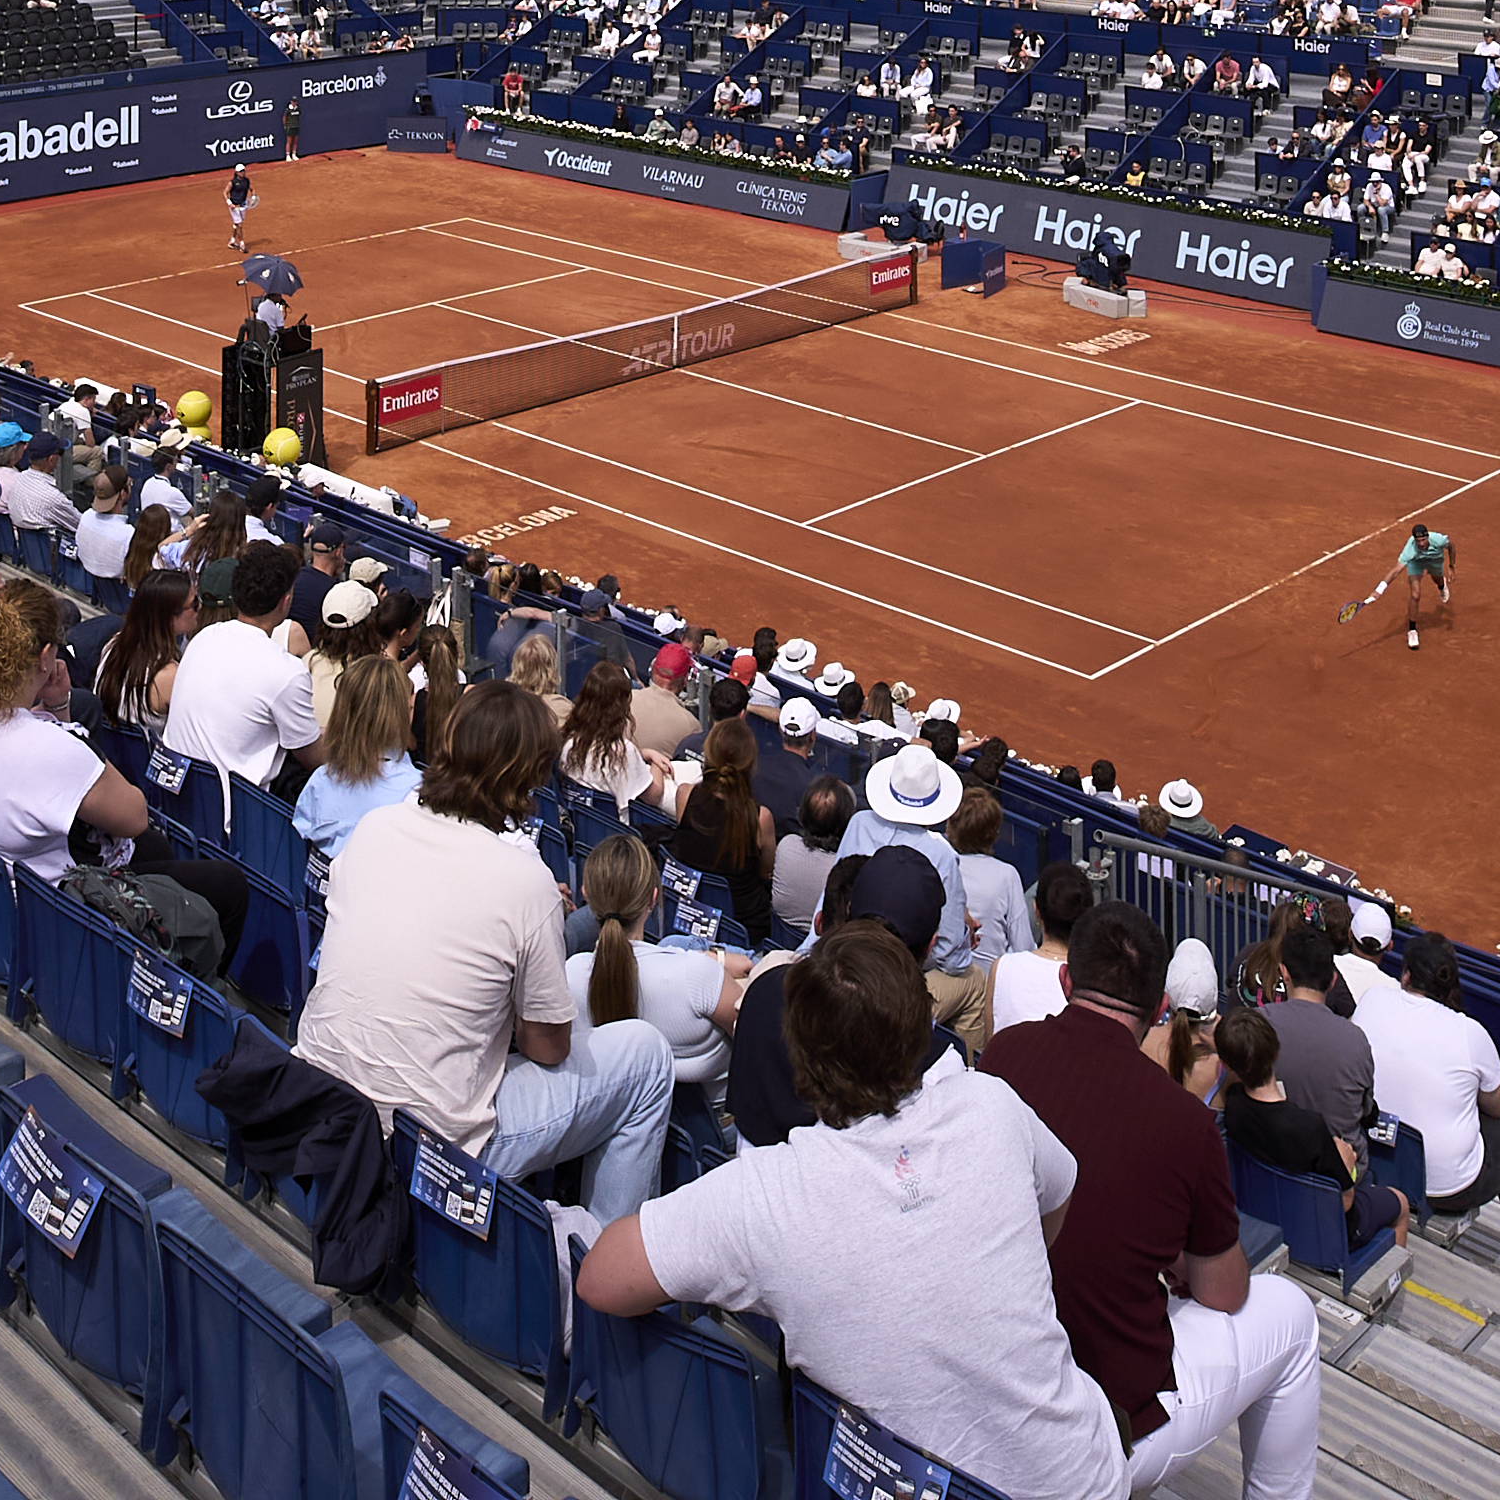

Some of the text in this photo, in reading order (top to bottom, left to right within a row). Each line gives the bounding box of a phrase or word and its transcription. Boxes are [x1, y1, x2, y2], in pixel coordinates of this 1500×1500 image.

[925, 1, 953, 14] Haier
[1098, 18, 1130, 32] Haier
[1294, 38, 1331, 54] Haier
[302, 74, 375, 98] Barcelona
[206, 100, 274, 119] LEXUS
[220, 134, 275, 155] Occident
[406, 131, 445, 141] TEKNON
[557, 151, 613, 177] Occident
[642, 165, 705, 190] VILARNAU
[736, 180, 808, 205] CLÍNICA TENIS
[760, 198, 806, 217] TEKNON
[908, 182, 1005, 234] Haier
[879, 214, 900, 227] rtve
[1033, 205, 1143, 259] Haier
[1175, 230, 1295, 288] Haier
[871, 264, 911, 286] Emirates
[1424, 320, 1492, 343] Real Club de Tenis
[622, 322, 736, 376] ATP TOUR
[382, 386, 439, 414] Emirates
